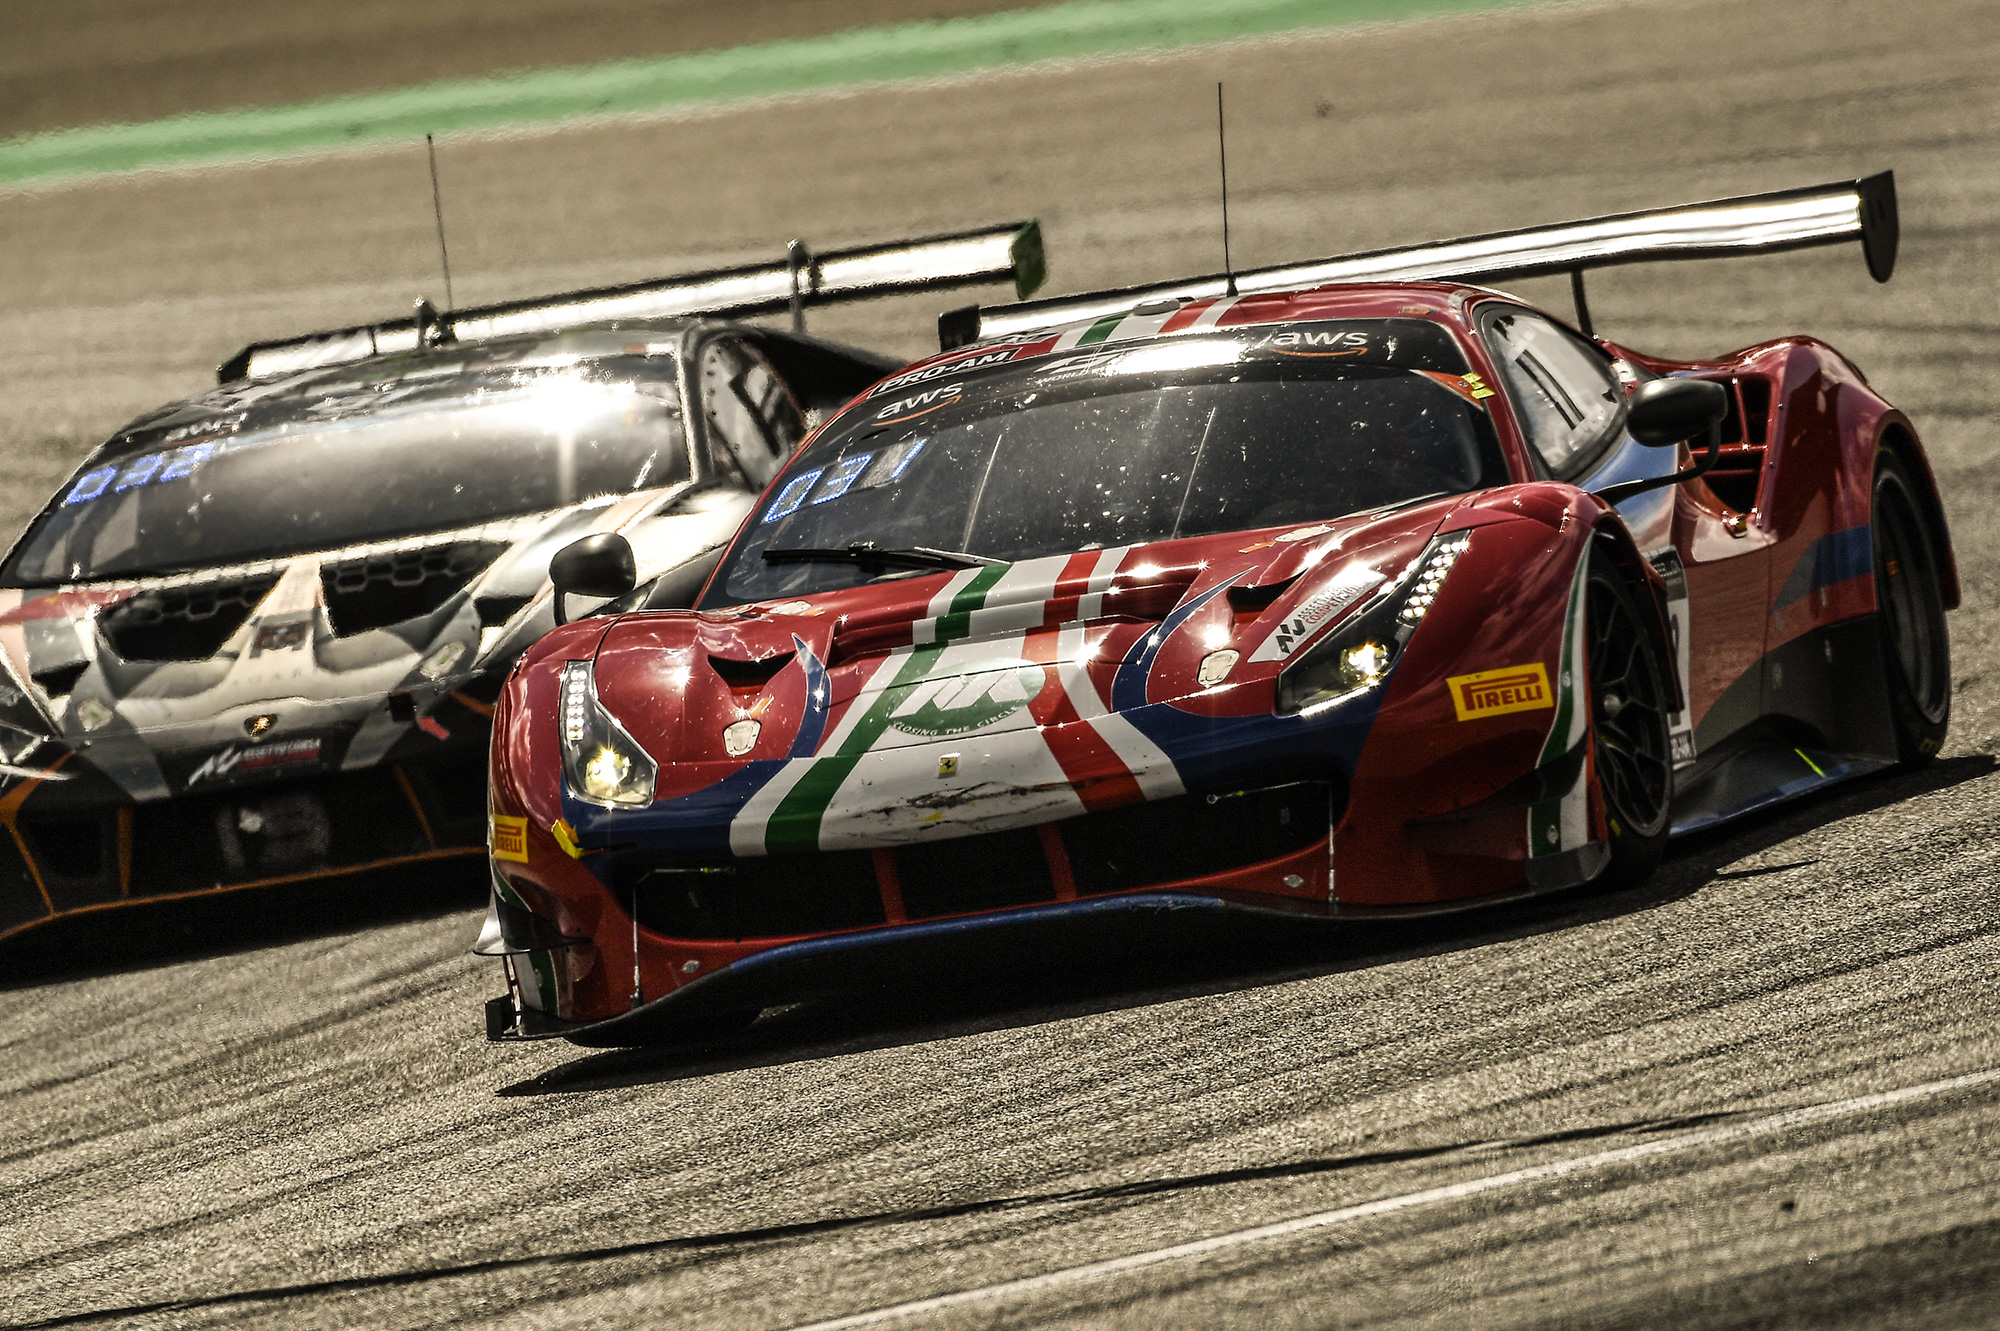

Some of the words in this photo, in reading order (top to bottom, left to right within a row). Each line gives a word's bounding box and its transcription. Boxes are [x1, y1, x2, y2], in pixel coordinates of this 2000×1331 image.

[1273, 332, 1368, 346] aws
[879, 351, 1010, 392] PRO-AM
[877, 382, 963, 419] aws
[66, 443, 215, 504] 032
[764, 438, 926, 523] 031
[1305, 585, 1362, 624] COMPETIZION
[1460, 672, 1543, 711] PIRELLI
[893, 720, 938, 736] CLOSING
[945, 725, 970, 735] THE
[977, 705, 1021, 727] CIRCLE
